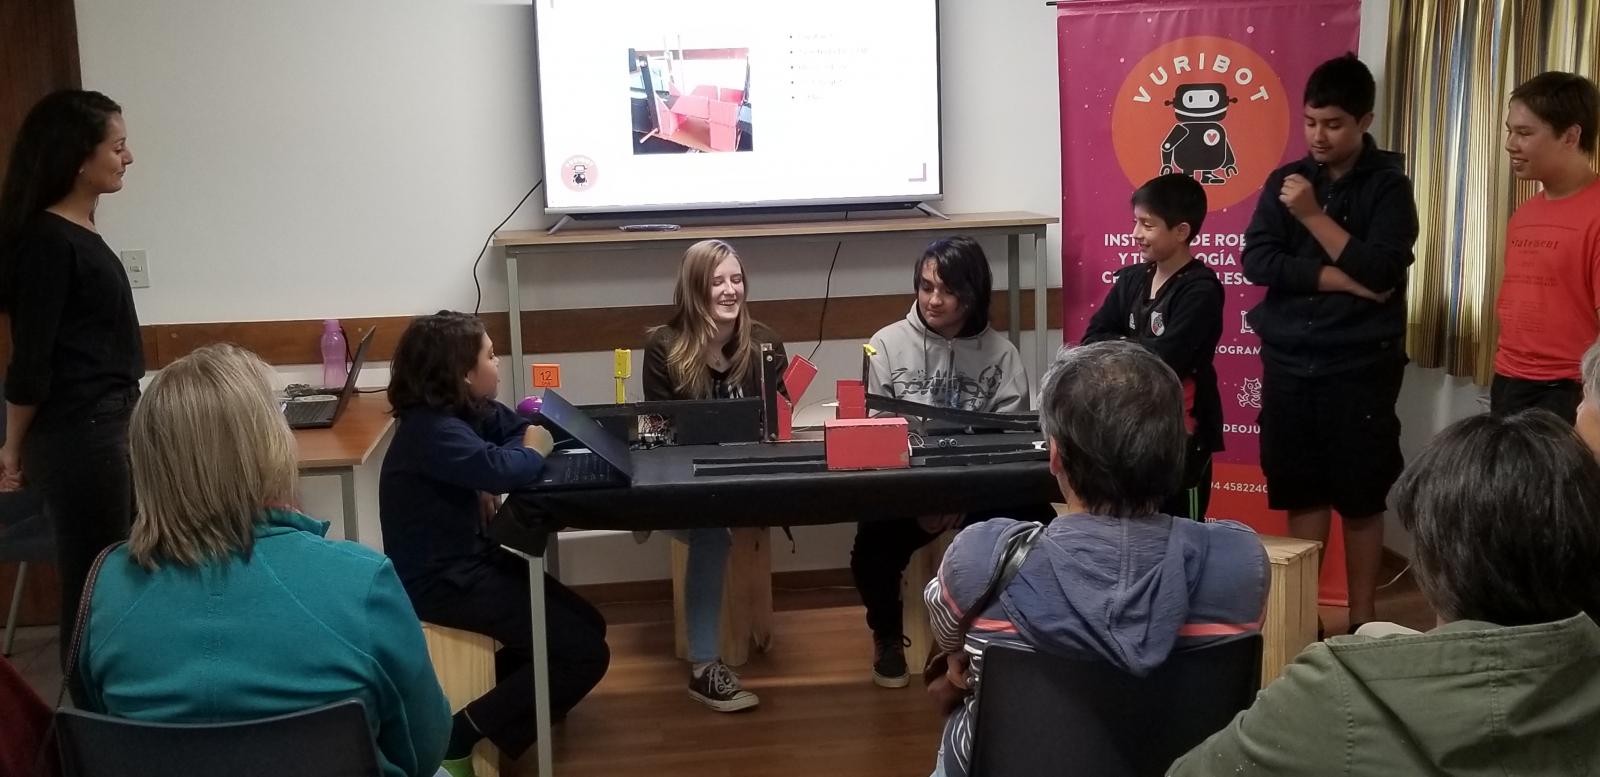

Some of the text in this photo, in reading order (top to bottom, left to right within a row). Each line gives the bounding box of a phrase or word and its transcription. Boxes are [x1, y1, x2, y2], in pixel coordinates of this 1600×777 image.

[1133, 53, 1269, 102] VURIBOT
[1190, 233, 1211, 247] DE
[1118, 252, 1129, 265] Y
[540, 370, 553, 381] 12
[1222, 424, 1261, 434] DEOJU
